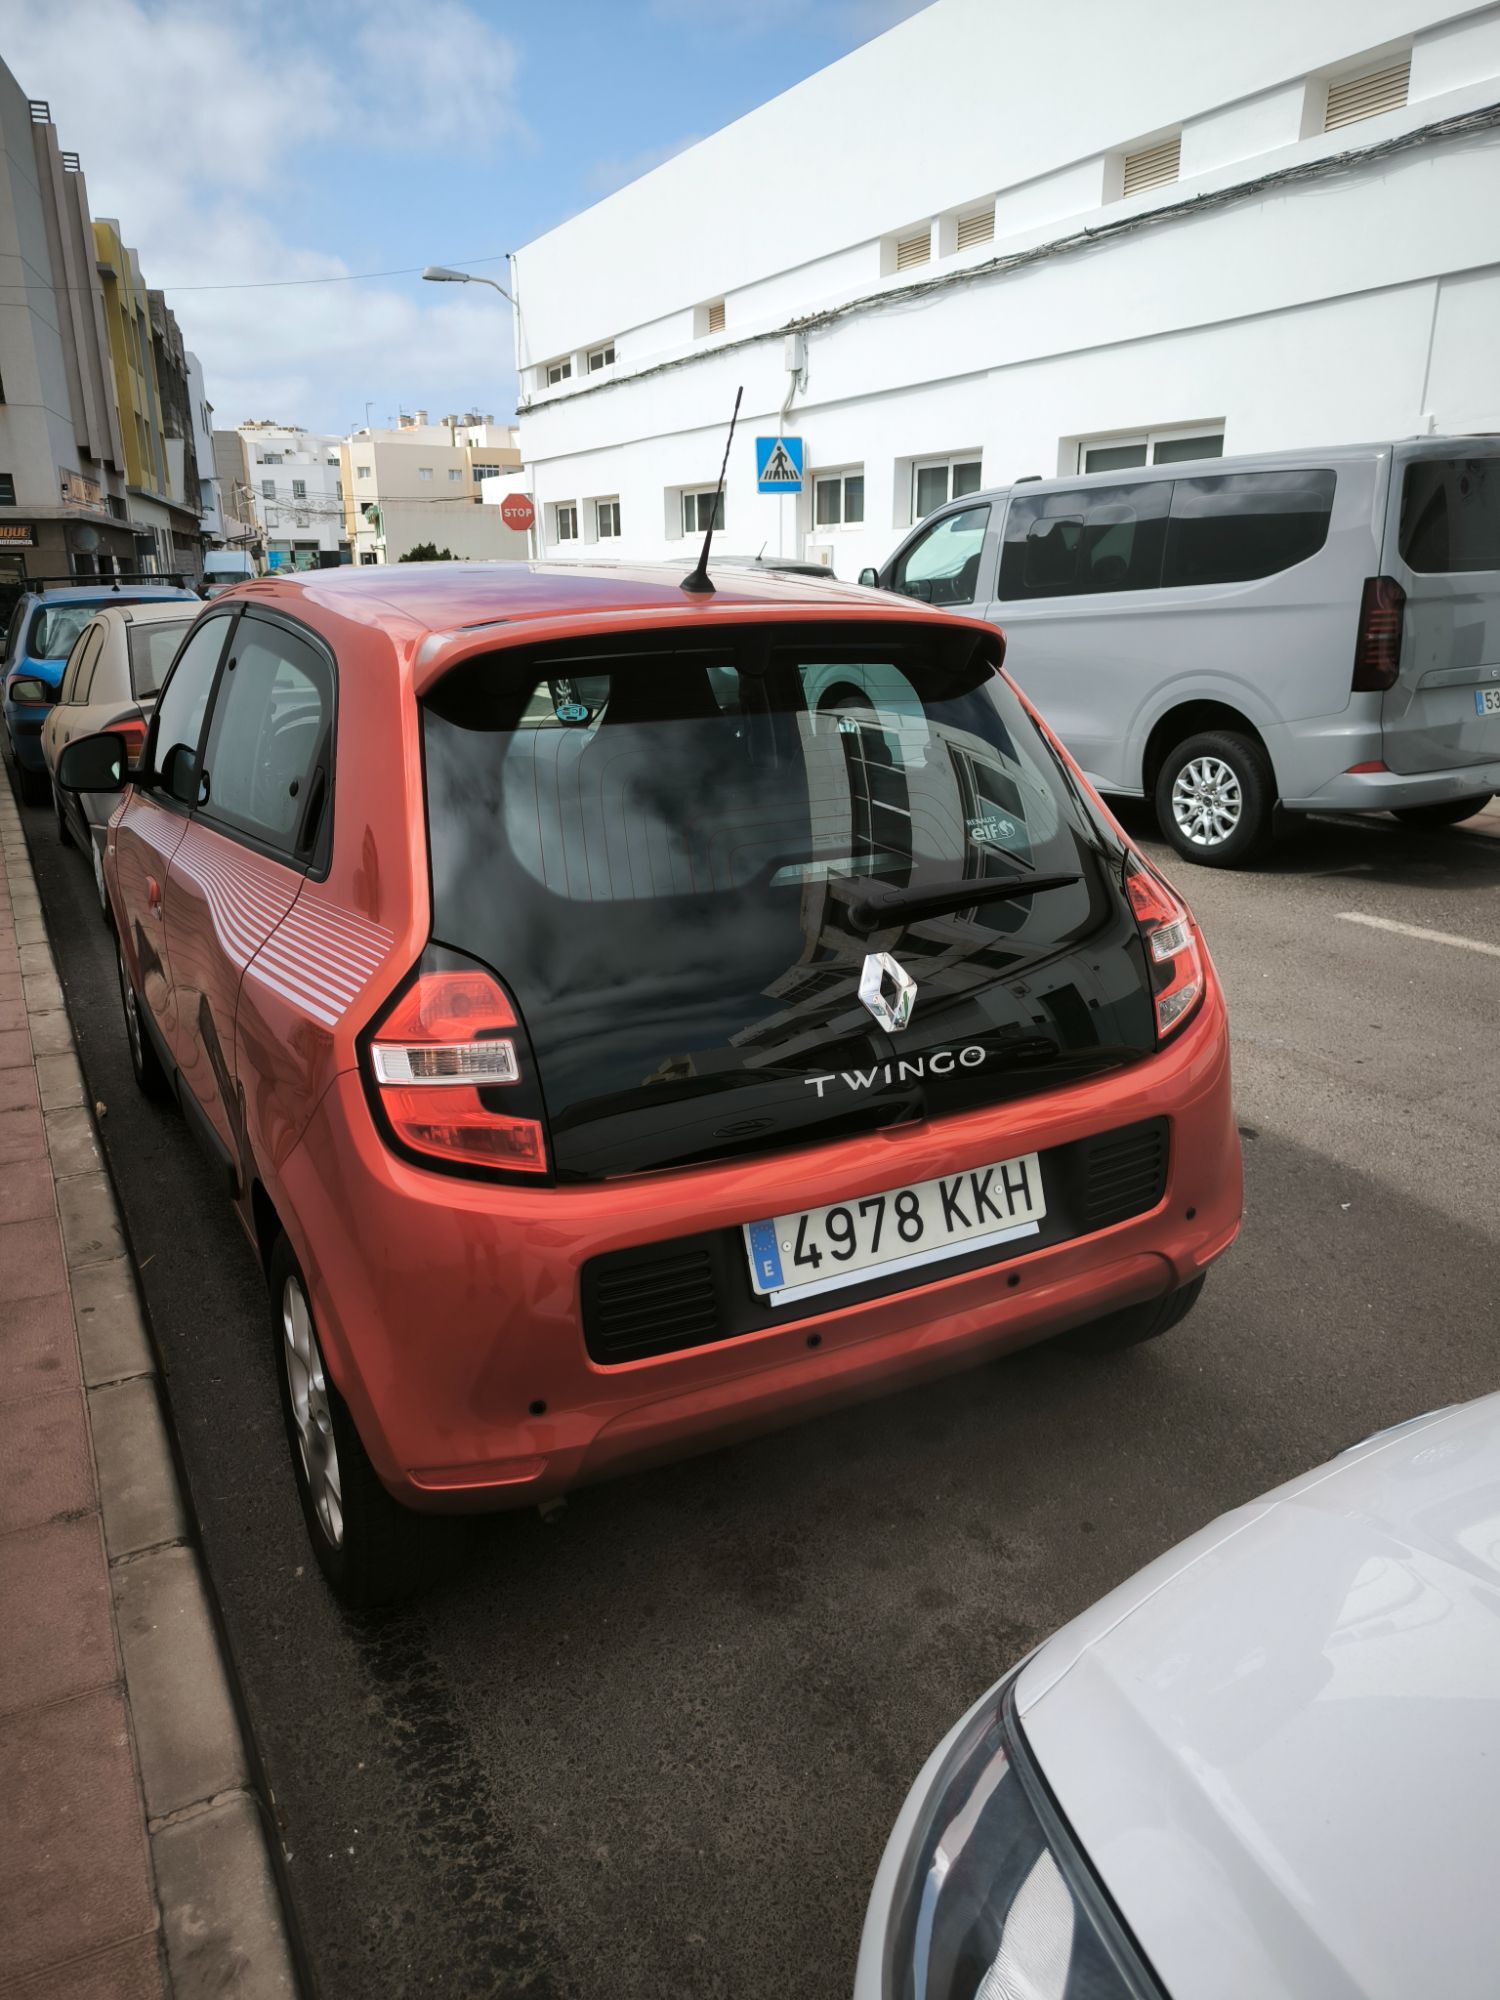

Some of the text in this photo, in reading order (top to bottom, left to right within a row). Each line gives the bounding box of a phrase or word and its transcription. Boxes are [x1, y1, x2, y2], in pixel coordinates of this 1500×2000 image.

[504, 507, 532, 518] STOP
[966, 816, 997, 826] RENAULT
[804, 1046, 986, 1097] TWINGO
[793, 1161, 1033, 1269] 4978 KKH
[763, 1260, 774, 1277] E
